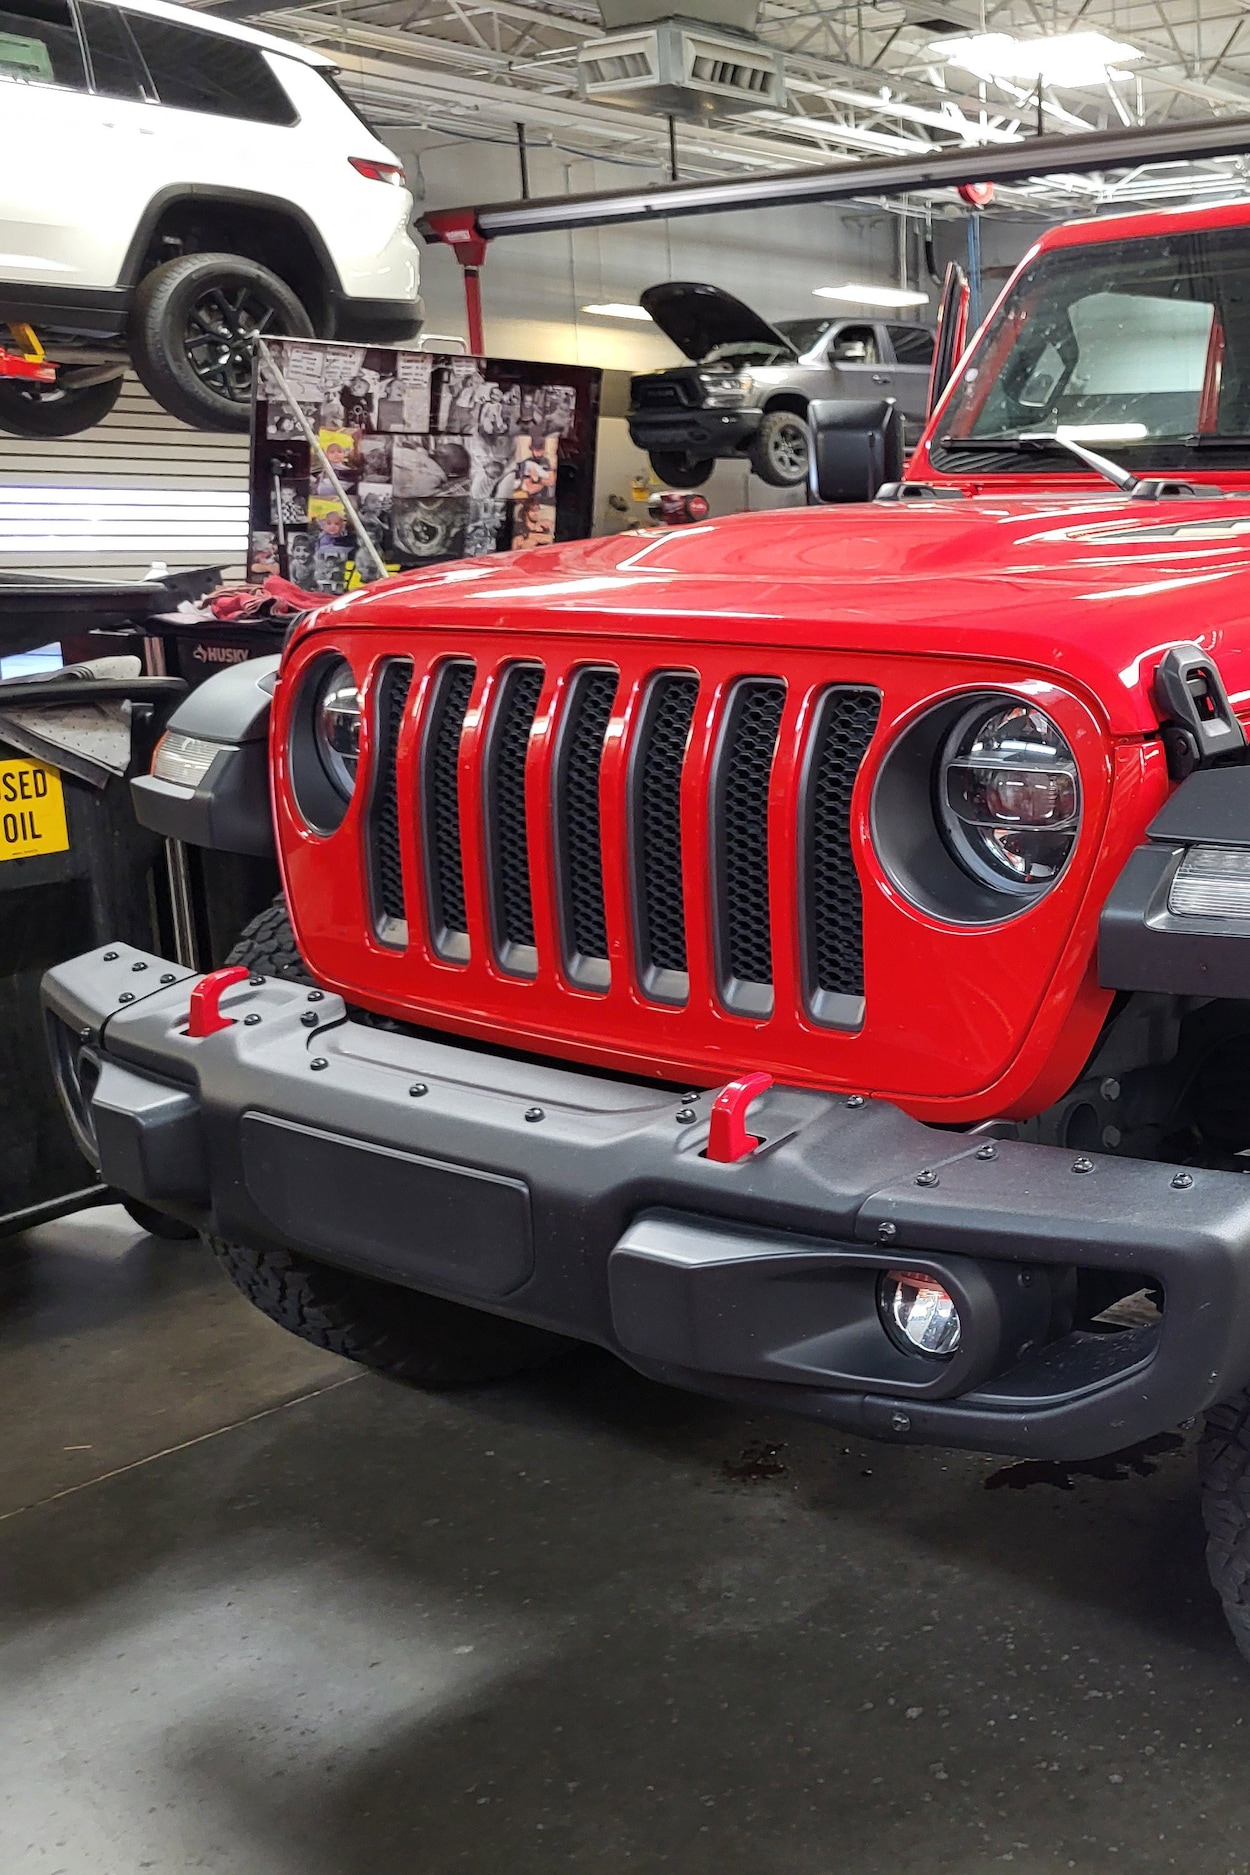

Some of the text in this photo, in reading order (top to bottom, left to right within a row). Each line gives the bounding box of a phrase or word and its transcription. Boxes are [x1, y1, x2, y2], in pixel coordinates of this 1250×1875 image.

[207, 646, 250, 663] HUSKY
[0, 768, 48, 802] SED
[3, 811, 43, 843] OIL
